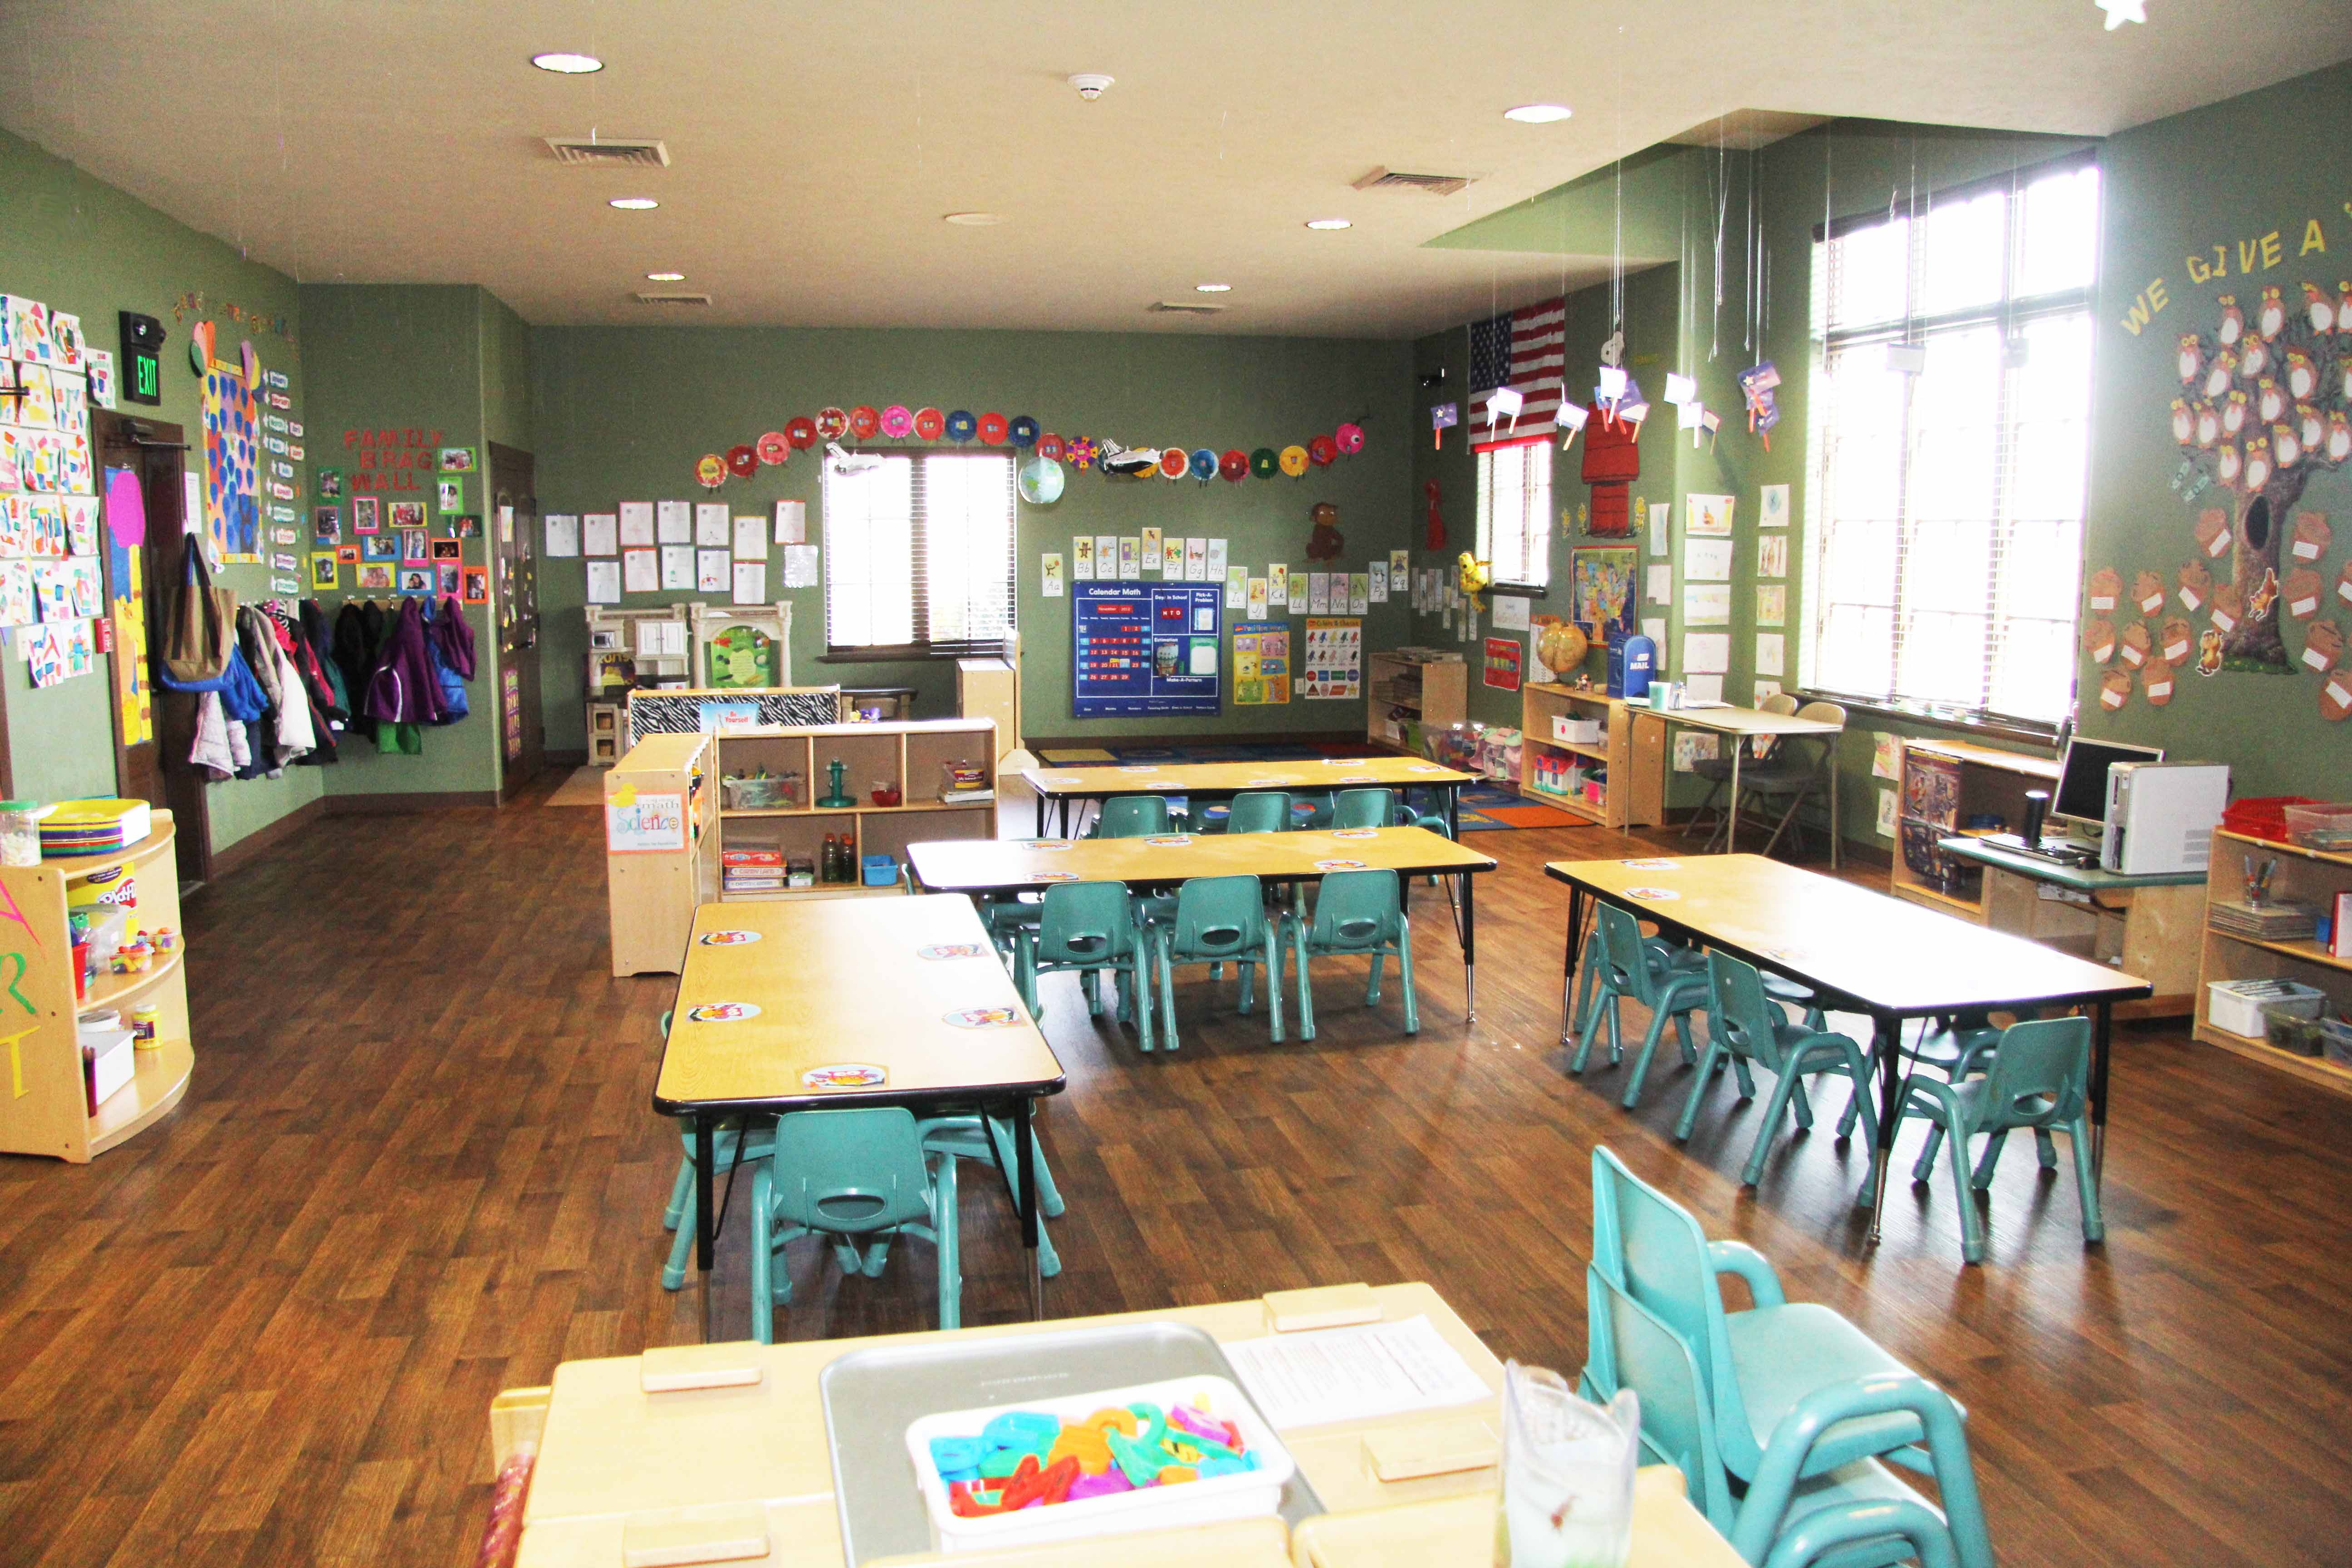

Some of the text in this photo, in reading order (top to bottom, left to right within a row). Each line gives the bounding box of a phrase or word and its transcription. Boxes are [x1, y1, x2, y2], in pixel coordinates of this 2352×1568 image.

[2120, 219, 2326, 337] WE GIVE A
[137, 355, 157, 397] EXIT
[344, 428, 444, 450] FAMILY
[360, 450, 432, 470] BRAG
[352, 471, 421, 491] WALL
[1145, 554, 1157, 564] Ee
[1077, 563, 1090, 573] Bb
[1100, 563, 1113, 573] Cc
[1122, 563, 1137, 573] Dd
[1166, 564, 1178, 574] Ff
[1190, 564, 1203, 578] Gg
[1210, 564, 1224, 575] Hh
[1046, 581, 1060, 590] Aa
[1373, 587, 1384, 600] Pp
[1311, 599, 1328, 608] Mm
[1332, 599, 1345, 608] Nn
[1630, 662, 1650, 670] MAIL
[617, 808, 679, 834] Science
